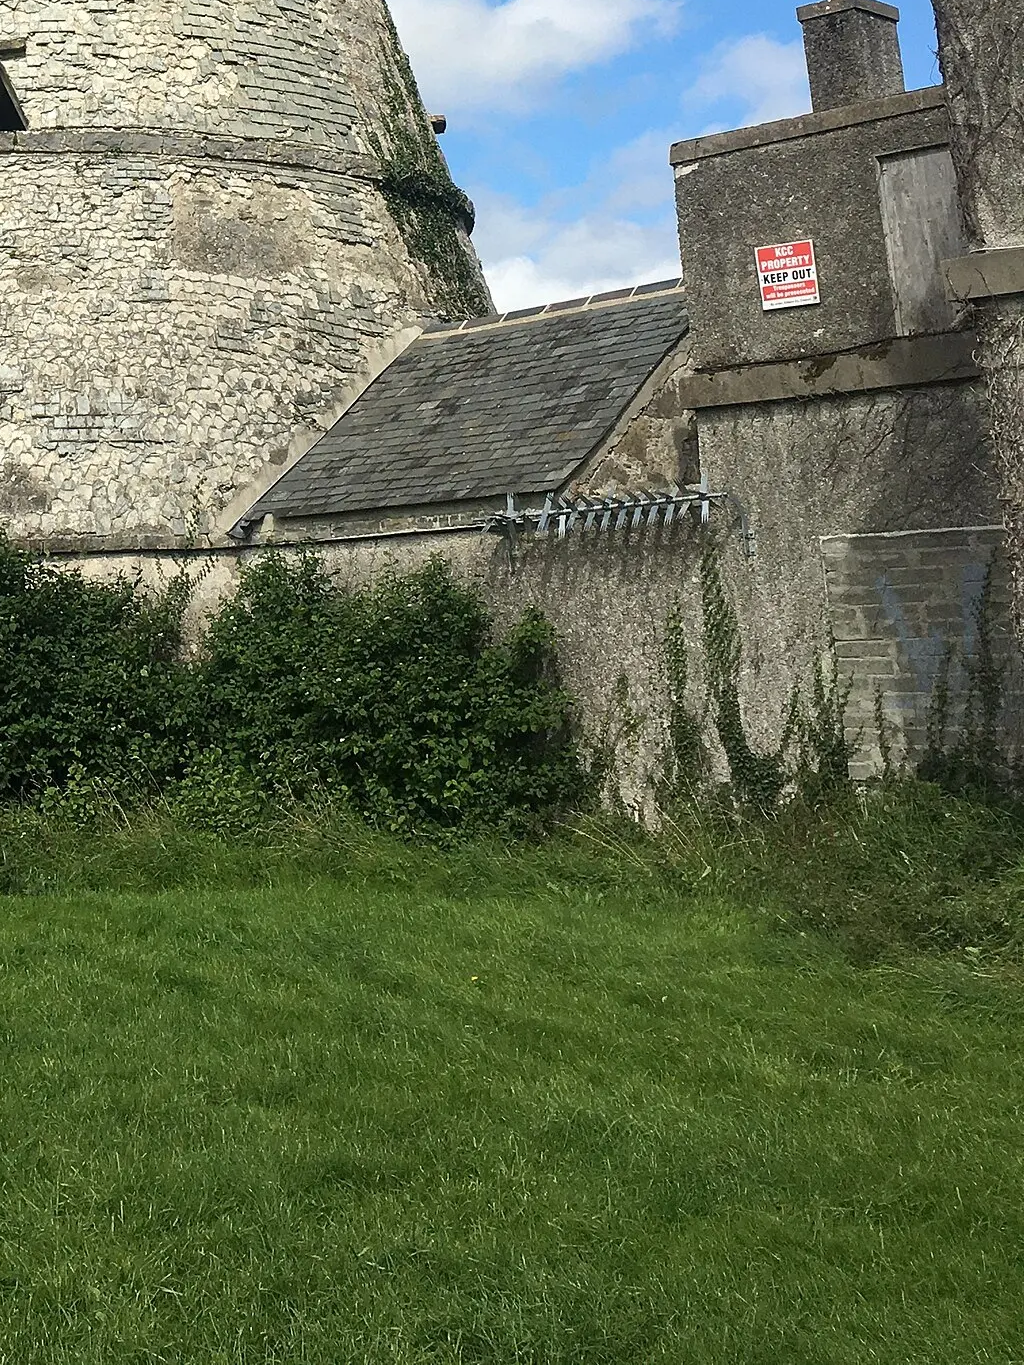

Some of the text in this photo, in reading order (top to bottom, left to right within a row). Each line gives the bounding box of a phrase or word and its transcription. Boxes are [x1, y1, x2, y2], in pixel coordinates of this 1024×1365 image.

[774, 245, 794, 257] KCC
[760, 254, 810, 271] PROPERTY
[763, 268, 812, 284] KEEP OUT
